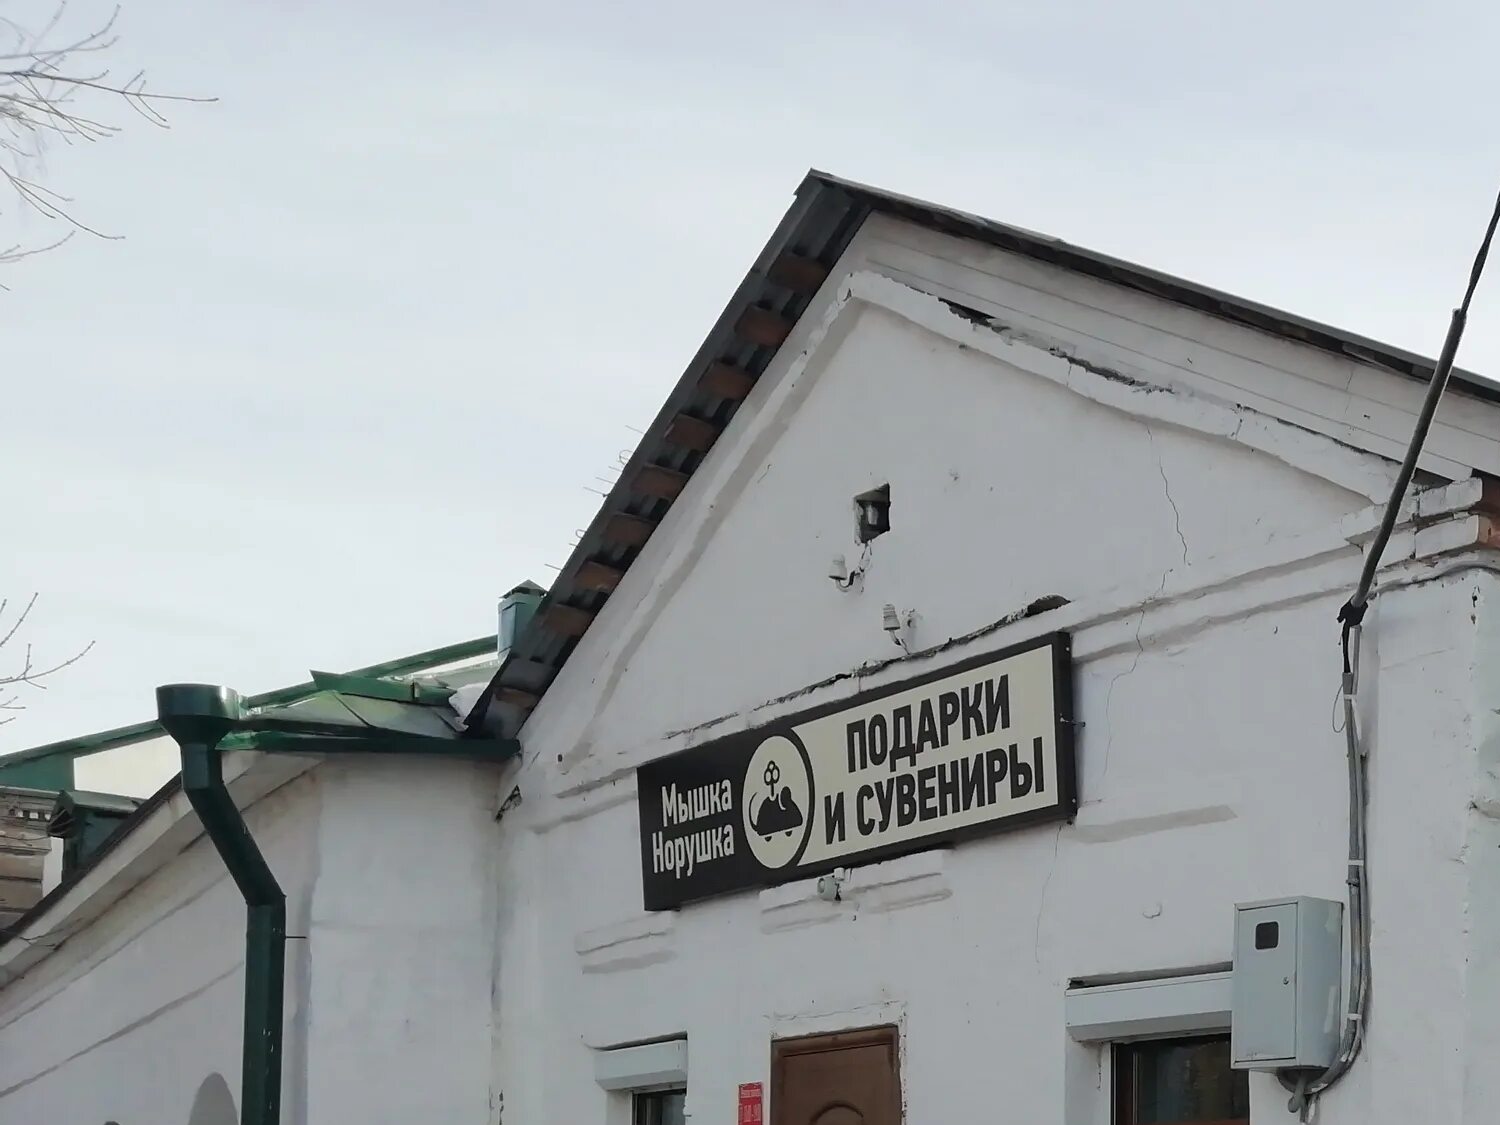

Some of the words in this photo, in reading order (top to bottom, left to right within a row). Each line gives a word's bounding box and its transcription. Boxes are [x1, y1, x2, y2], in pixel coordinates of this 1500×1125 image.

[846, 673, 1011, 774] ПОДАРКИ
[661, 777, 733, 828] Мышка
[824, 791, 847, 845] И
[856, 736, 1047, 836] СУВЕНИРЫ
[651, 821, 735, 879] Норушка
